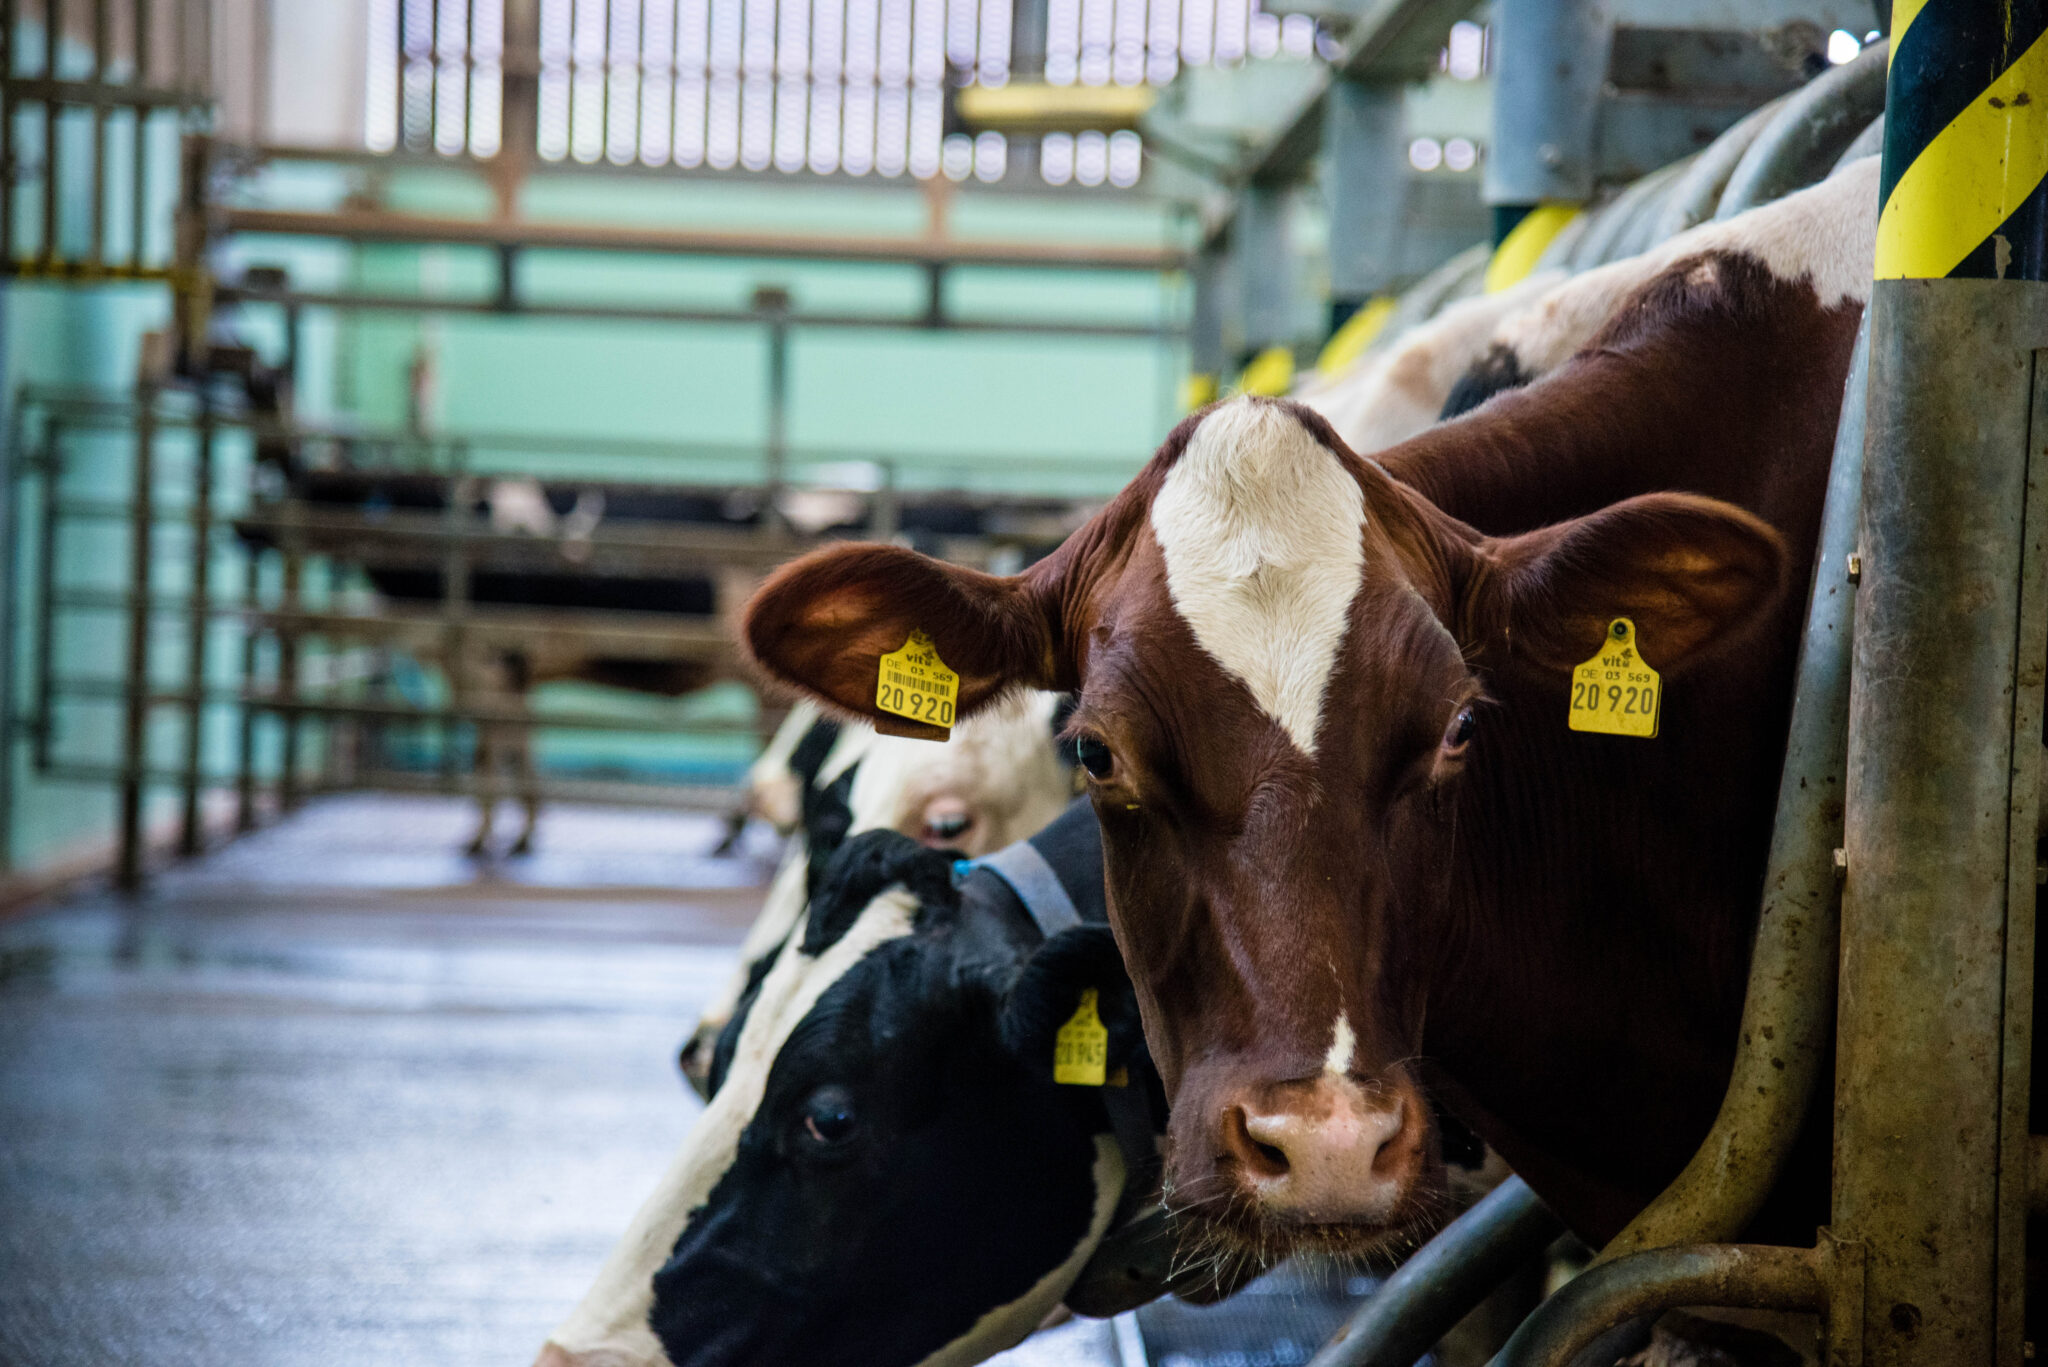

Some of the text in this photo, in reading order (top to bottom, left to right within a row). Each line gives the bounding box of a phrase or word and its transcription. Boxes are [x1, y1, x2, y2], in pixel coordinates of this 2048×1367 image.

[886, 658, 953, 682] DE 03 569
[1581, 669, 1650, 683] DE 03 569
[880, 684, 953, 724] 20 920
[1573, 682, 1653, 714] 20 920
